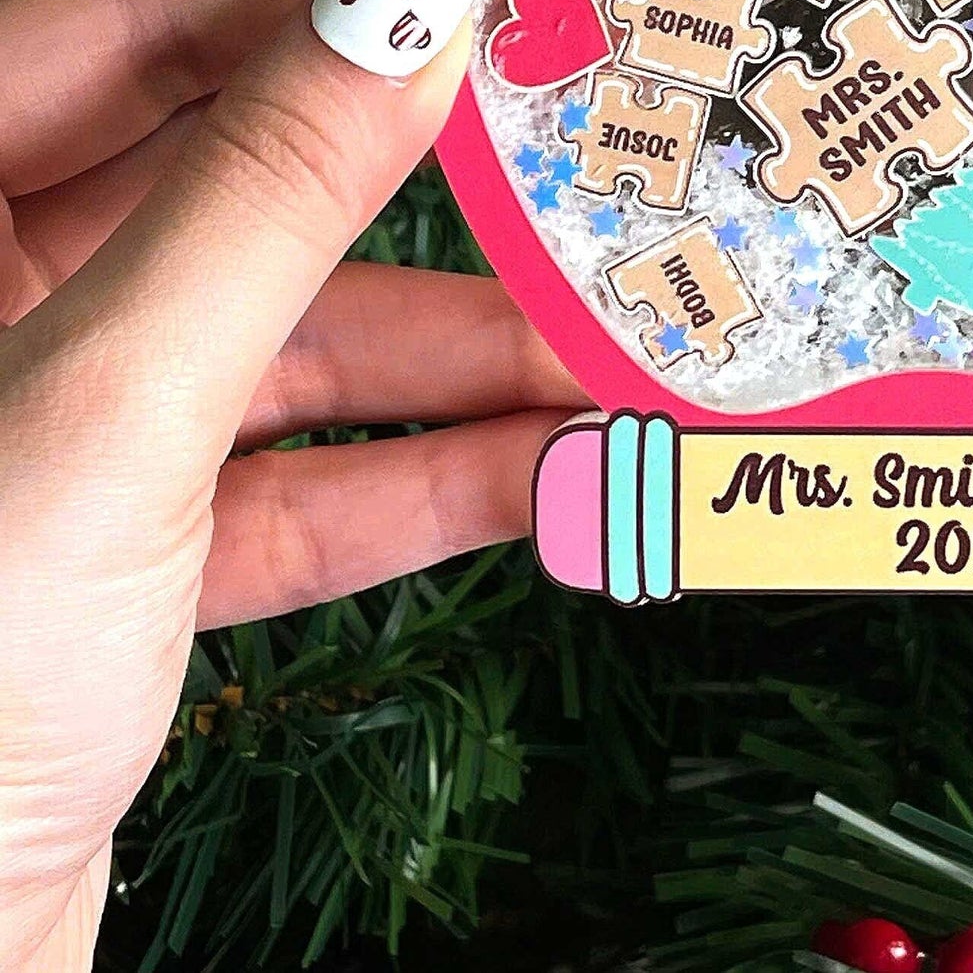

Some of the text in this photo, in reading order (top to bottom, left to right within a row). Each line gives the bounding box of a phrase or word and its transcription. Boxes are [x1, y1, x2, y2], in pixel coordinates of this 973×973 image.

[643, 5, 734, 51] SOPHIA
[801, 60, 904, 140] MRS.
[819, 77, 942, 182] SMITH
[597, 122, 678, 162] JOSUE
[659, 253, 716, 329] BODHI
[711, 452, 853, 516] Mrs.
